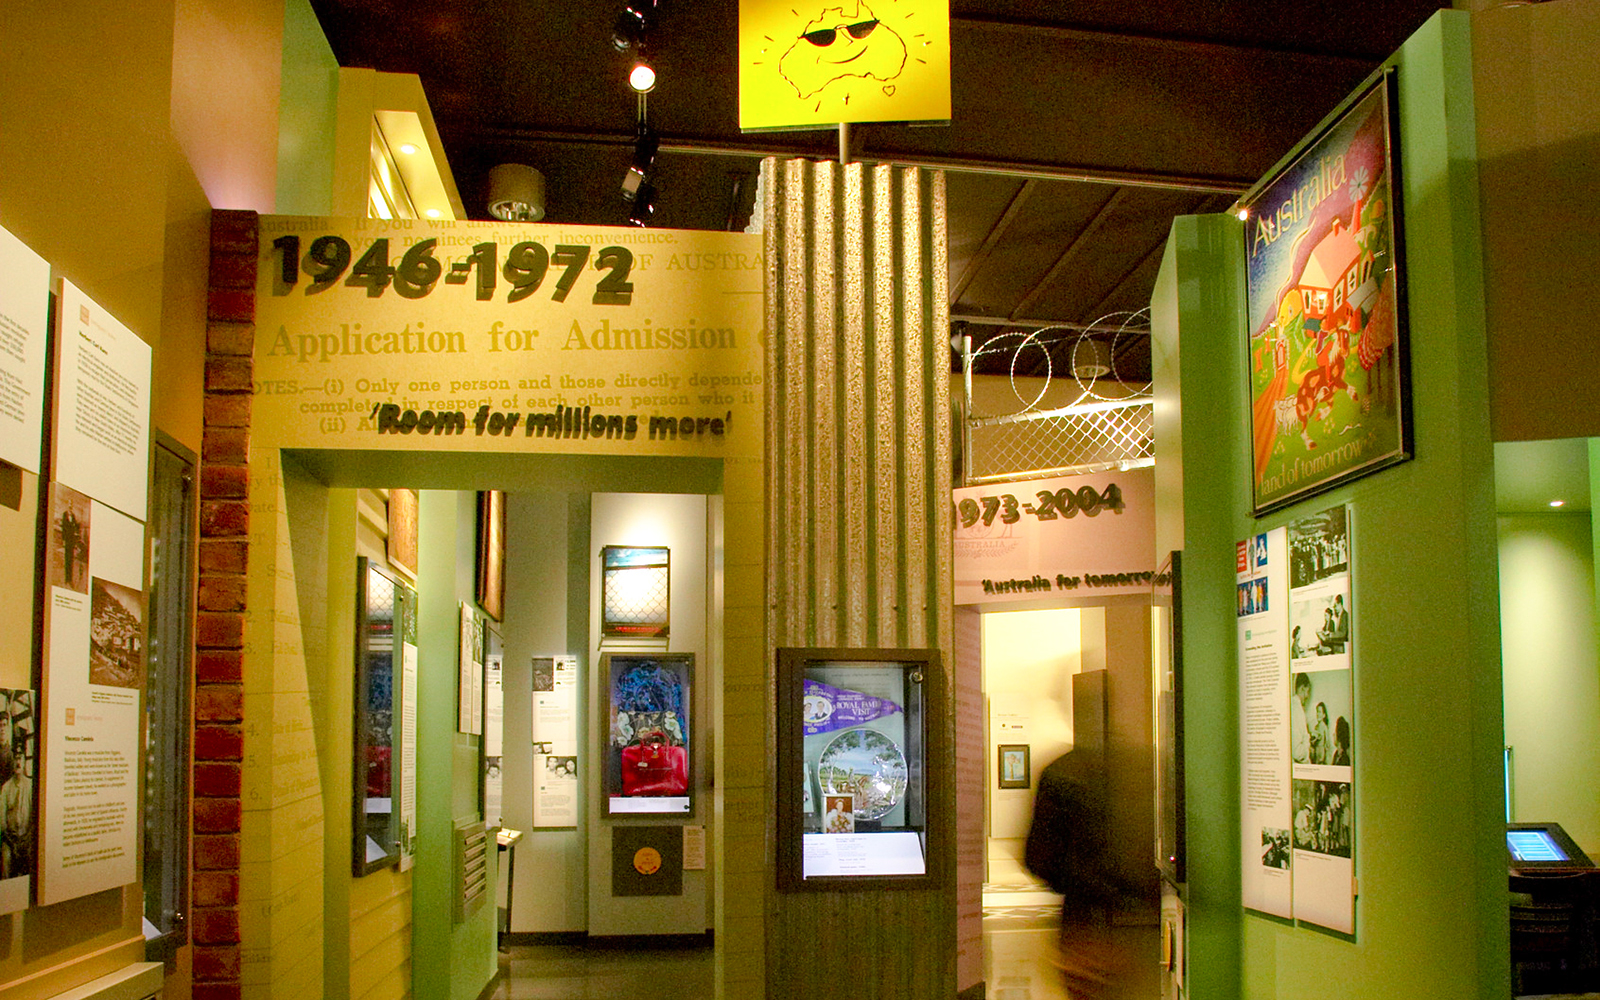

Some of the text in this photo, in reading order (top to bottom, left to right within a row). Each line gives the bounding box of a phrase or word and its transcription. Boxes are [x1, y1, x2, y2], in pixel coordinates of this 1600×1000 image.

[1252, 153, 1347, 258] Australia
[381, 219, 414, 232] you
[559, 231, 679, 245] inconvenience.
[273, 236, 635, 306] 1946-1972
[267, 318, 738, 363] Application for Admission
[355, 377, 400, 396] Only
[408, 379, 441, 393] one
[449, 379, 511, 394] person
[518, 375, 552, 390] and
[559, 374, 606, 390] those
[614, 373, 681, 390] directly
[402, 397, 420, 411] in
[501, 394, 519, 410] of
[576, 391, 622, 408] other
[630, 393, 690, 409] person
[698, 391, 735, 405] who
[320, 416, 346, 435] (ii)
[473, 404, 520, 437] for
[525, 403, 640, 441] millions
[1260, 462, 1286, 496] land
[1287, 456, 1300, 485] of
[1056, 573, 1082, 592] for
